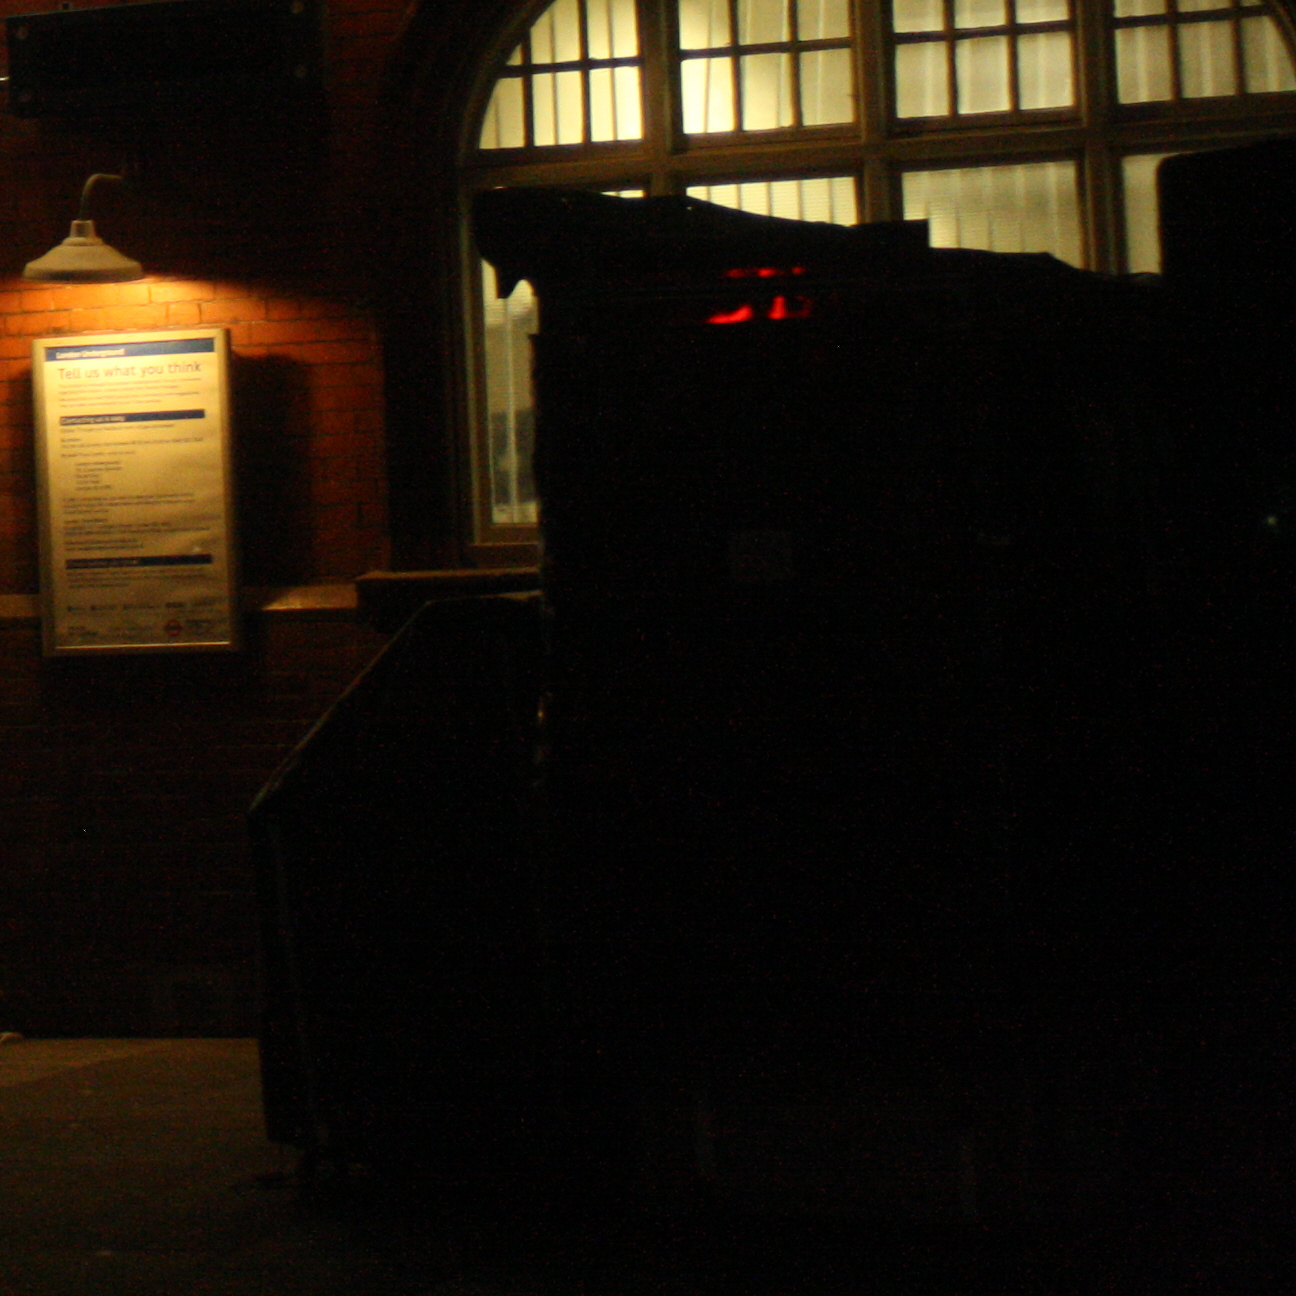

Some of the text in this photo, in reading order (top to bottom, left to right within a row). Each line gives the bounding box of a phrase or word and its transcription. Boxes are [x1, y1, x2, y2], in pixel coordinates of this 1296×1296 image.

[58, 361, 201, 380] Tell us what you think
